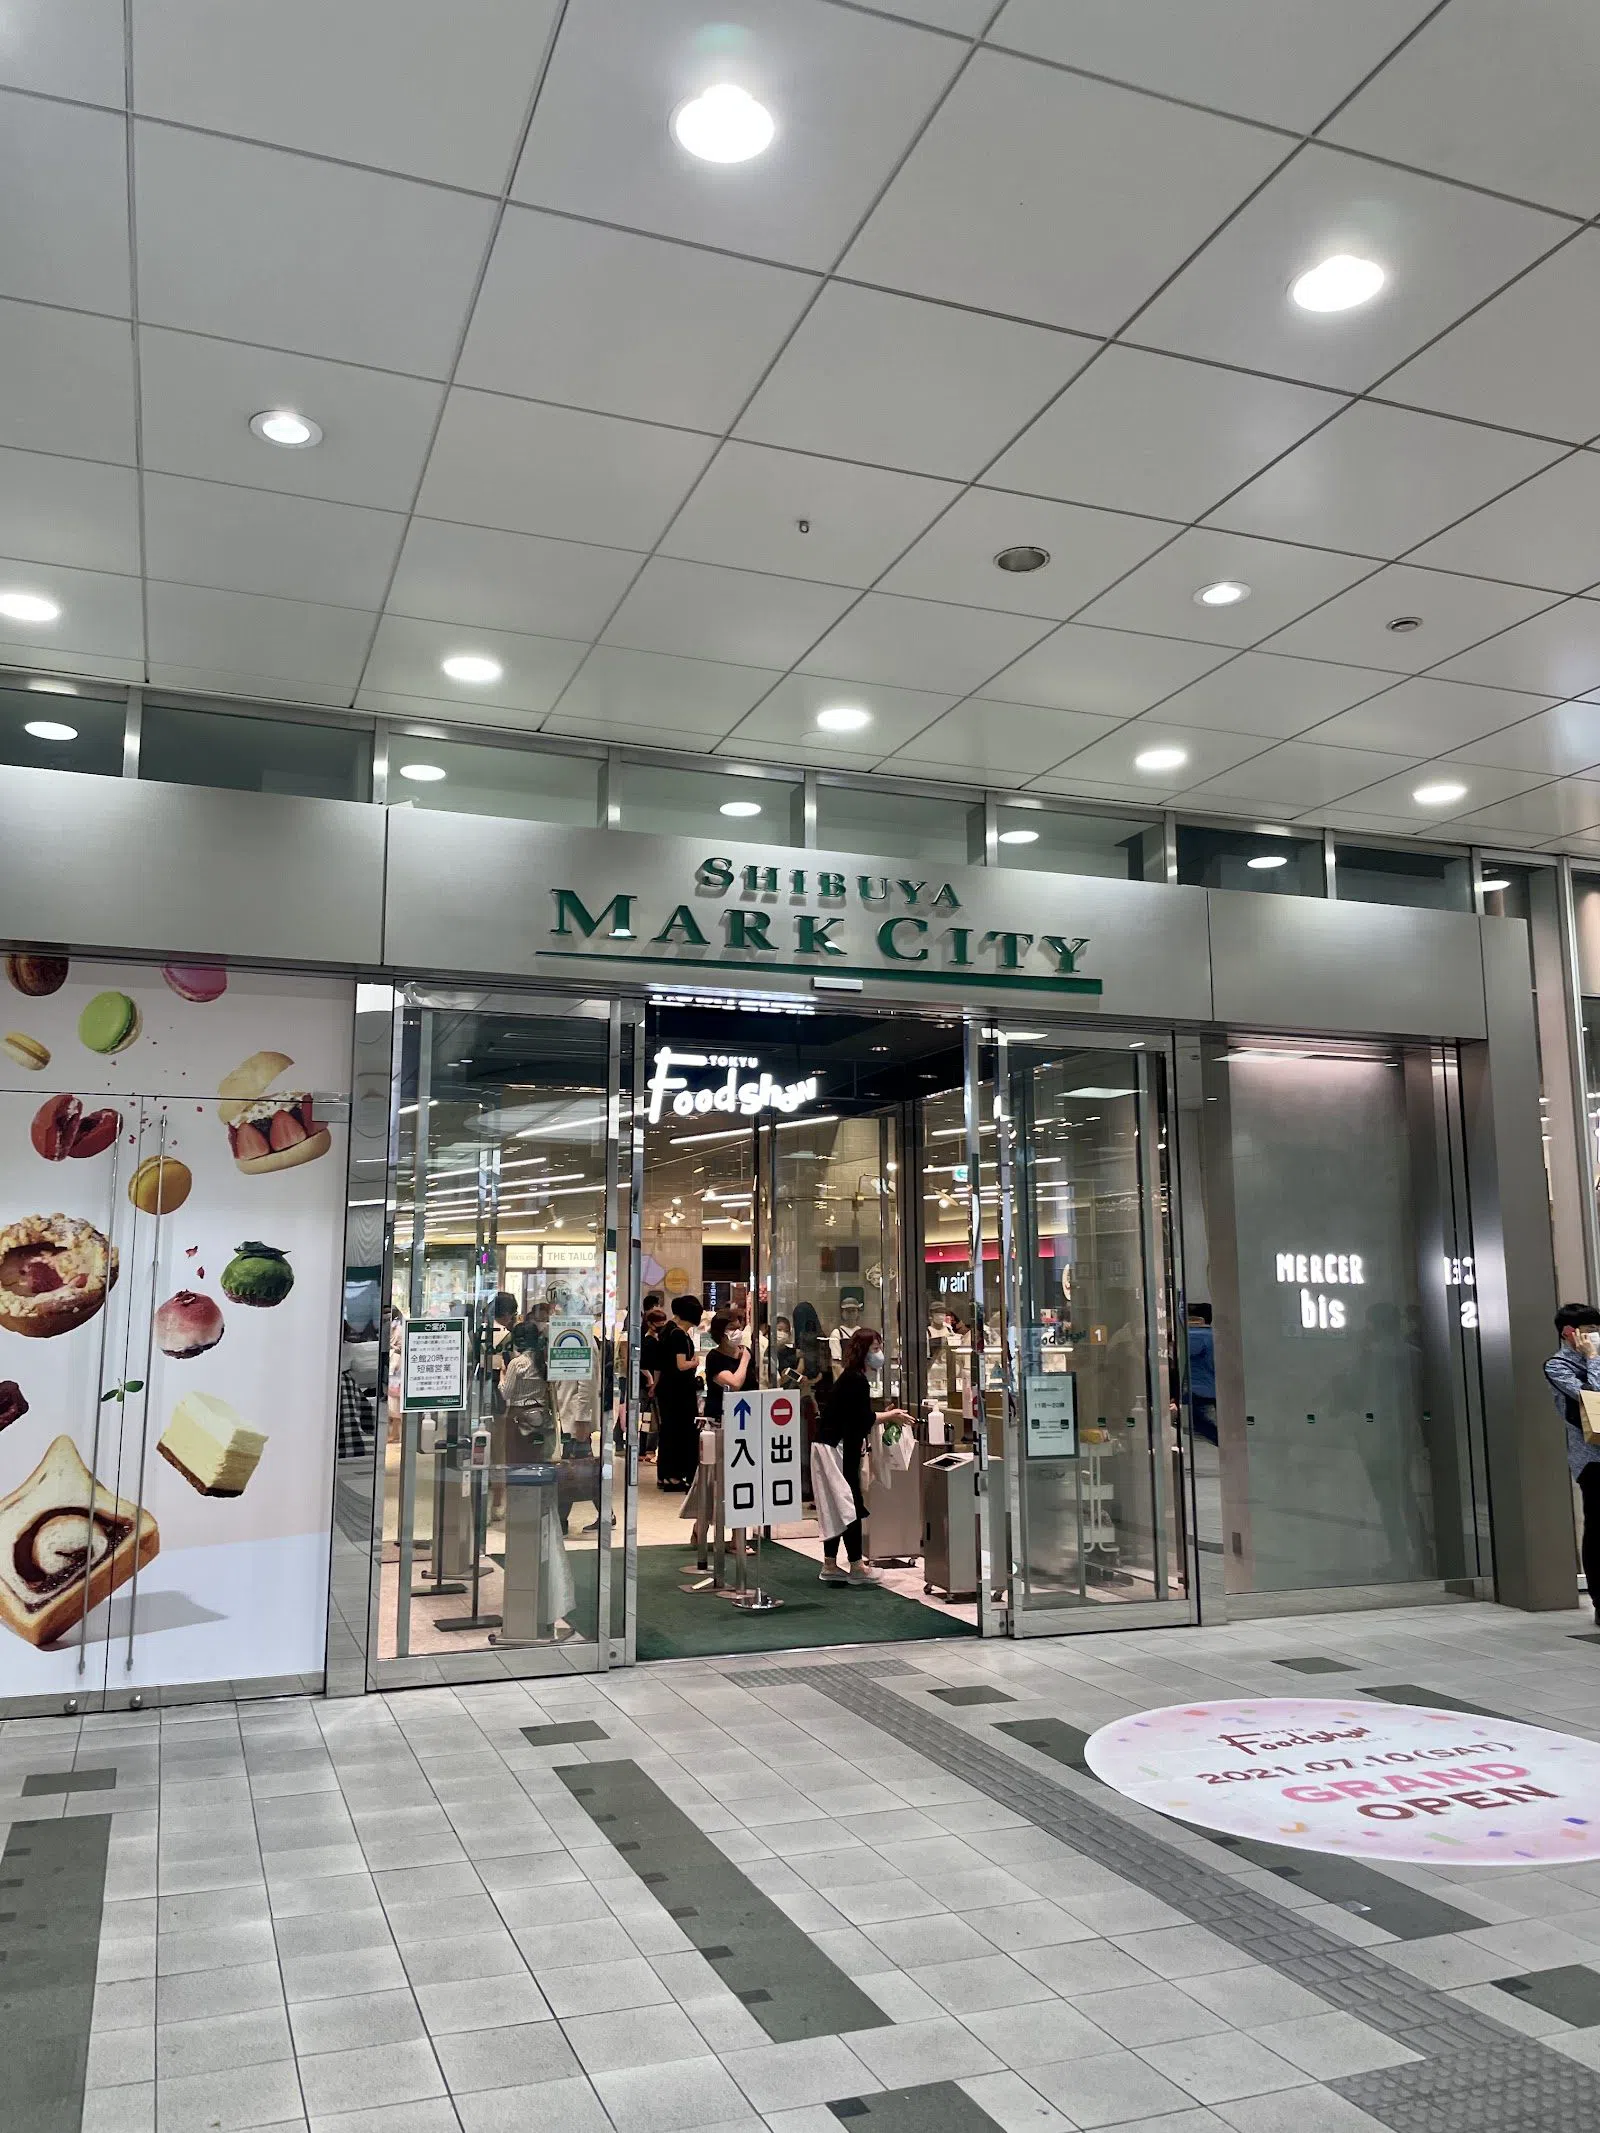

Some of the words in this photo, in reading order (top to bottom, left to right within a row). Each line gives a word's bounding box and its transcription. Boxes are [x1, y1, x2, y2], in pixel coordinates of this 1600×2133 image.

[701, 856, 963, 909] SHIBUYA
[551, 888, 849, 957] MARK
[877, 916, 1092, 974] CITY
[708, 1054, 759, 1069] TOKYU
[547, 1252, 566, 1261] THE
[1275, 1253, 1365, 1285] MERCER
[731, 1438, 756, 1510] 入口
[770, 1434, 793, 1506] 出口
[1197, 1741, 1517, 1785] 2021.07.10(SAT)
[1281, 1763, 1531, 1803] GRAND
[1356, 1784, 1561, 1821] OPEN
